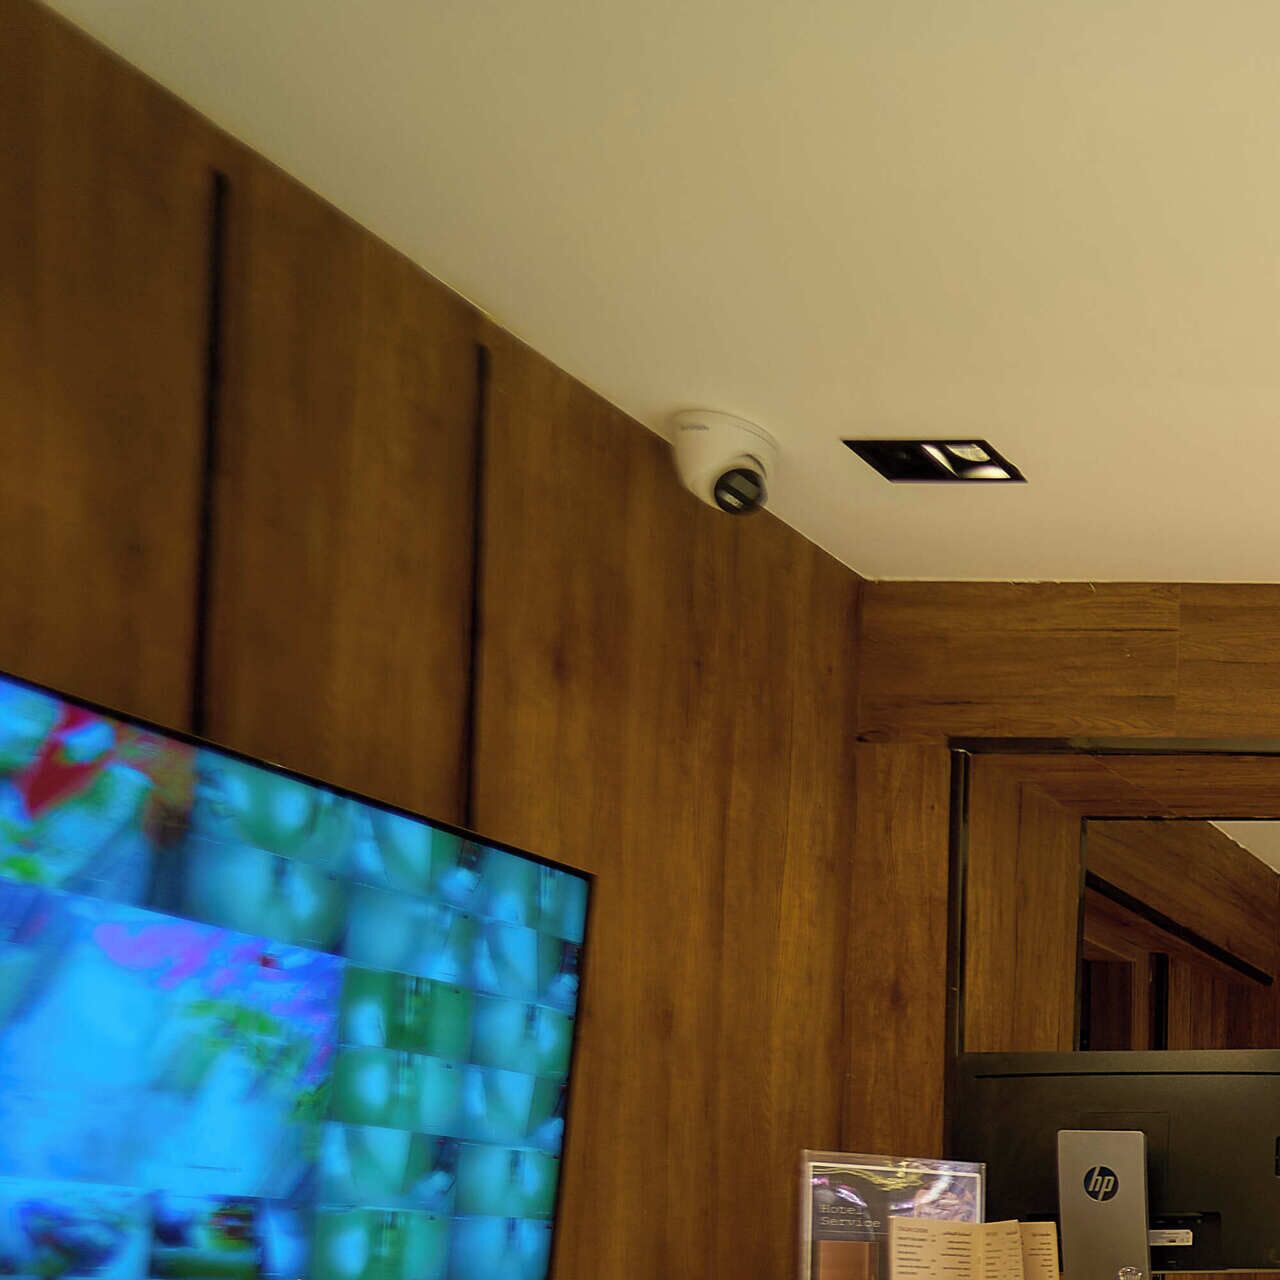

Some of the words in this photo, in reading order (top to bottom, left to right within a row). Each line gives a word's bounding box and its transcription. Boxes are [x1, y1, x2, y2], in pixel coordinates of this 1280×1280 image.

[1088, 1166, 1115, 1201] hp
[820, 1204, 864, 1215] Hotel
[821, 1216, 881, 1228] Service
